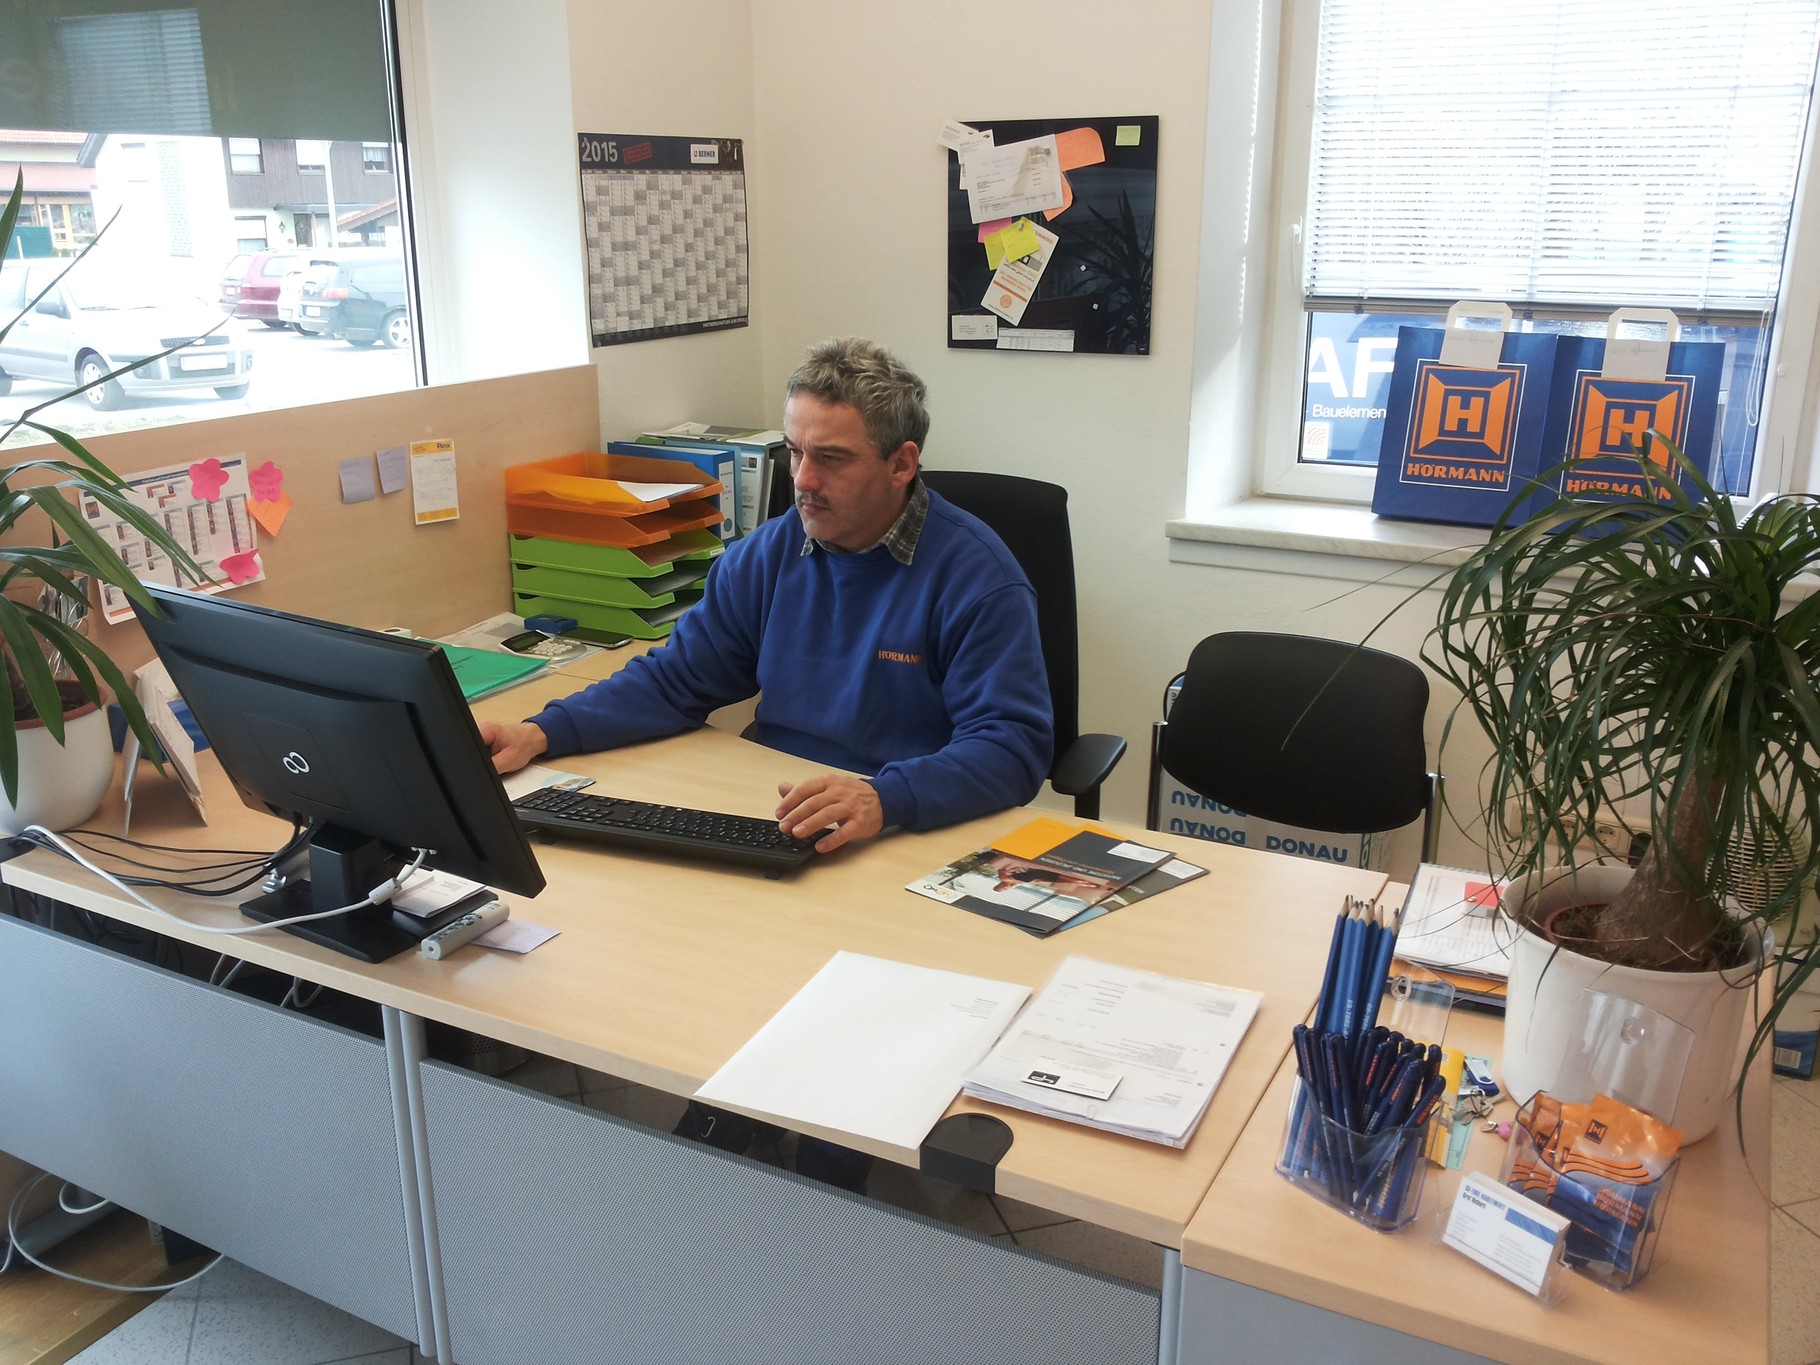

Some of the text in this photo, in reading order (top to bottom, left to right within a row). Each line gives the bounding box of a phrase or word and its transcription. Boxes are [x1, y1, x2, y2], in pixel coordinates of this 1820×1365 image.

[581, 137, 618, 162] 2015
[1312, 403, 1387, 419] Bauelemen
[1407, 463, 1505, 483] HÖRMANN
[1170, 817, 1246, 845] DONAU
[1266, 835, 1348, 863] DONAU
